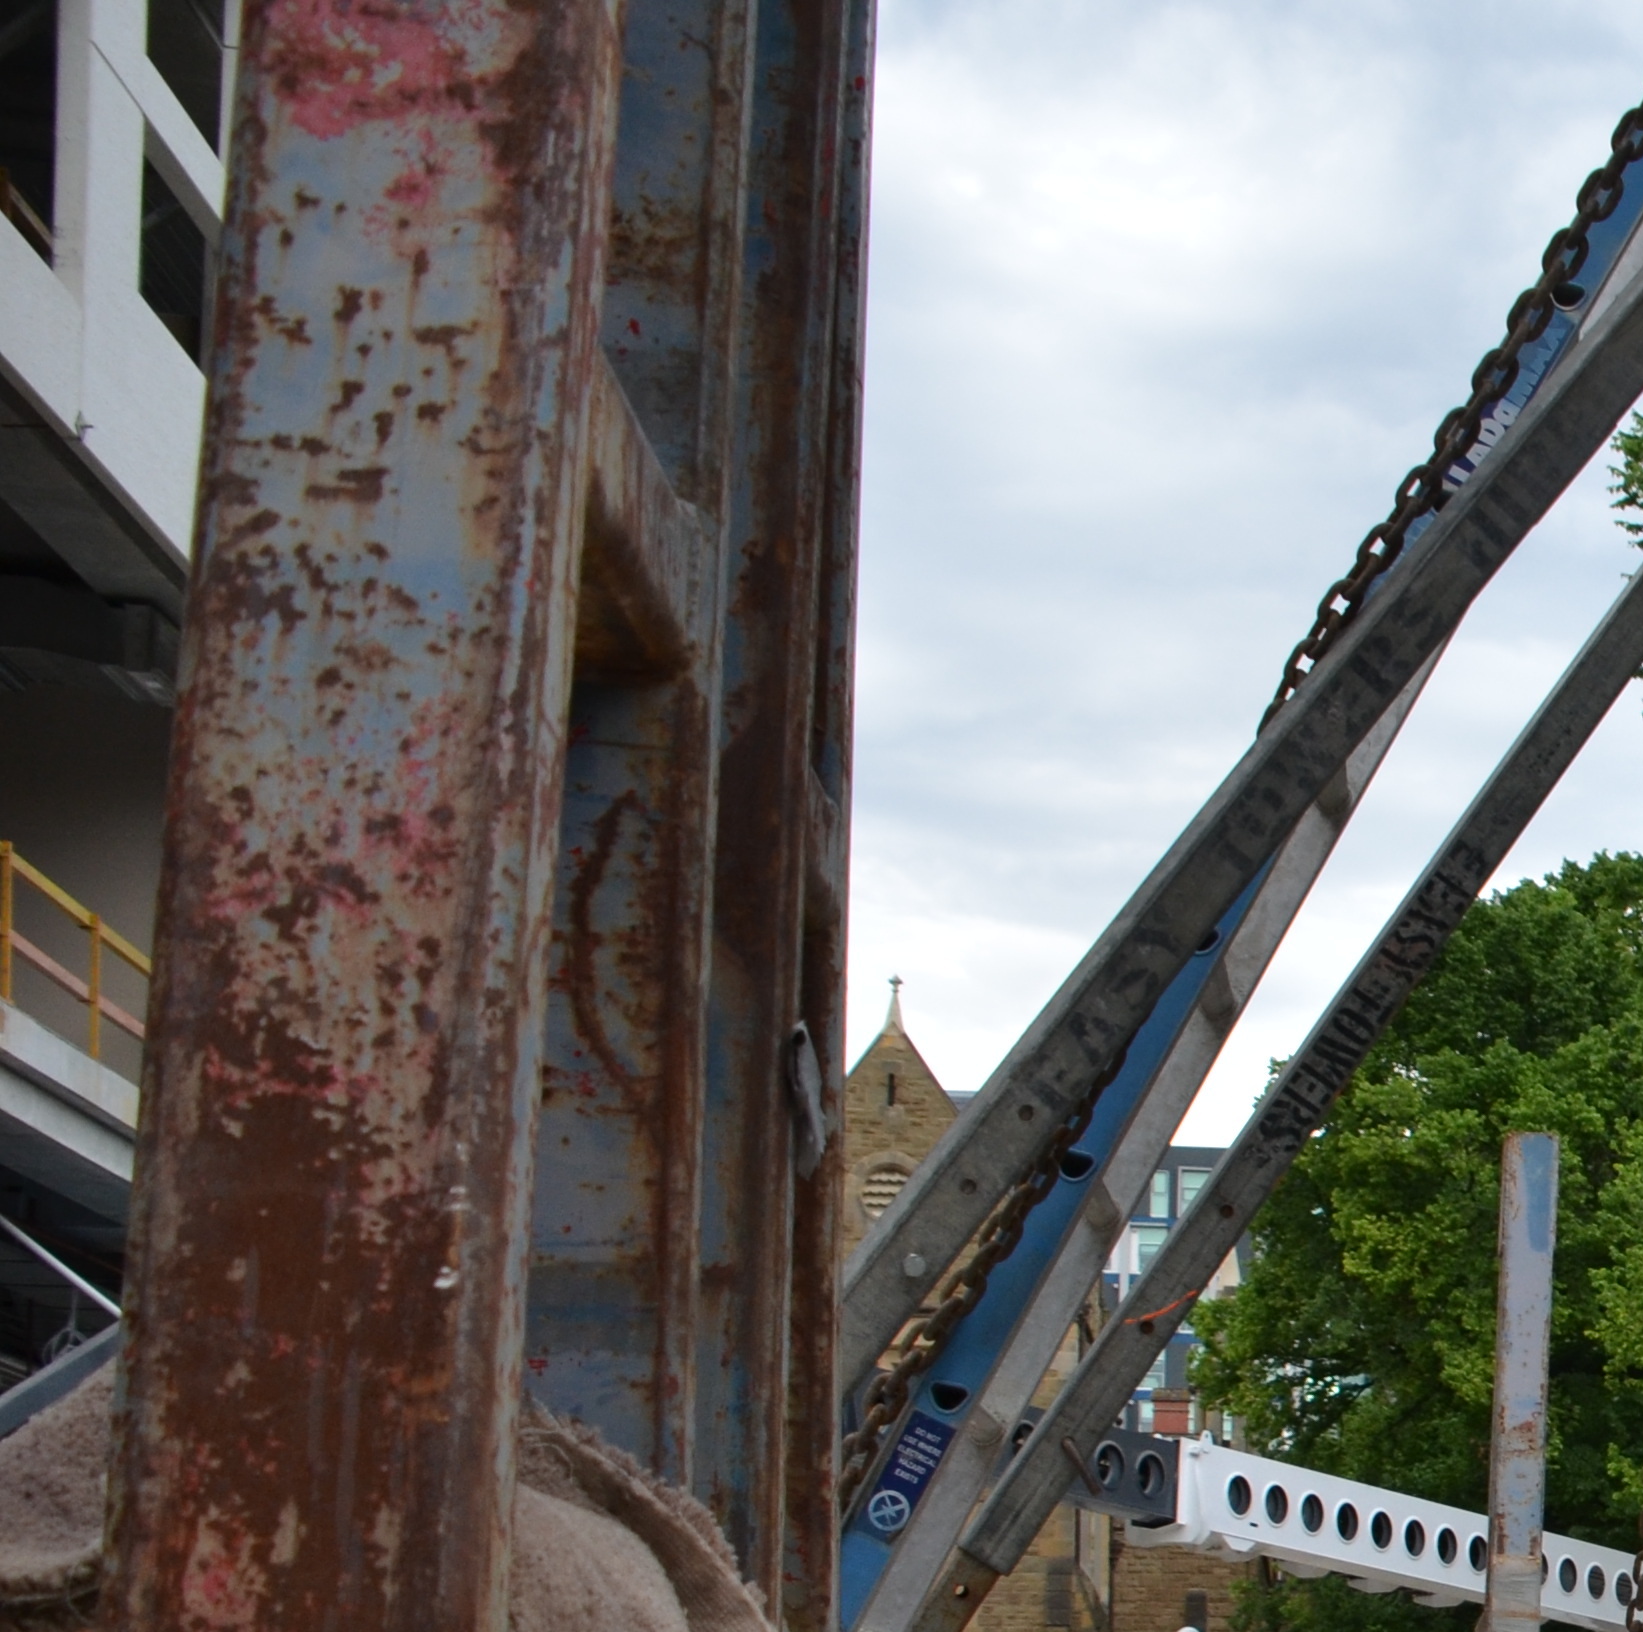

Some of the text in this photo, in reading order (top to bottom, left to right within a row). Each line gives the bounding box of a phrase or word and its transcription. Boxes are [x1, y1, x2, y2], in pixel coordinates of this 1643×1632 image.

[1259, 869, 1471, 1148] EASY TOWERS
[926, 1433, 942, 1443] NOT
[897, 1444, 937, 1468] ELECTRICAL
[898, 1458, 927, 1475] HAZARD
